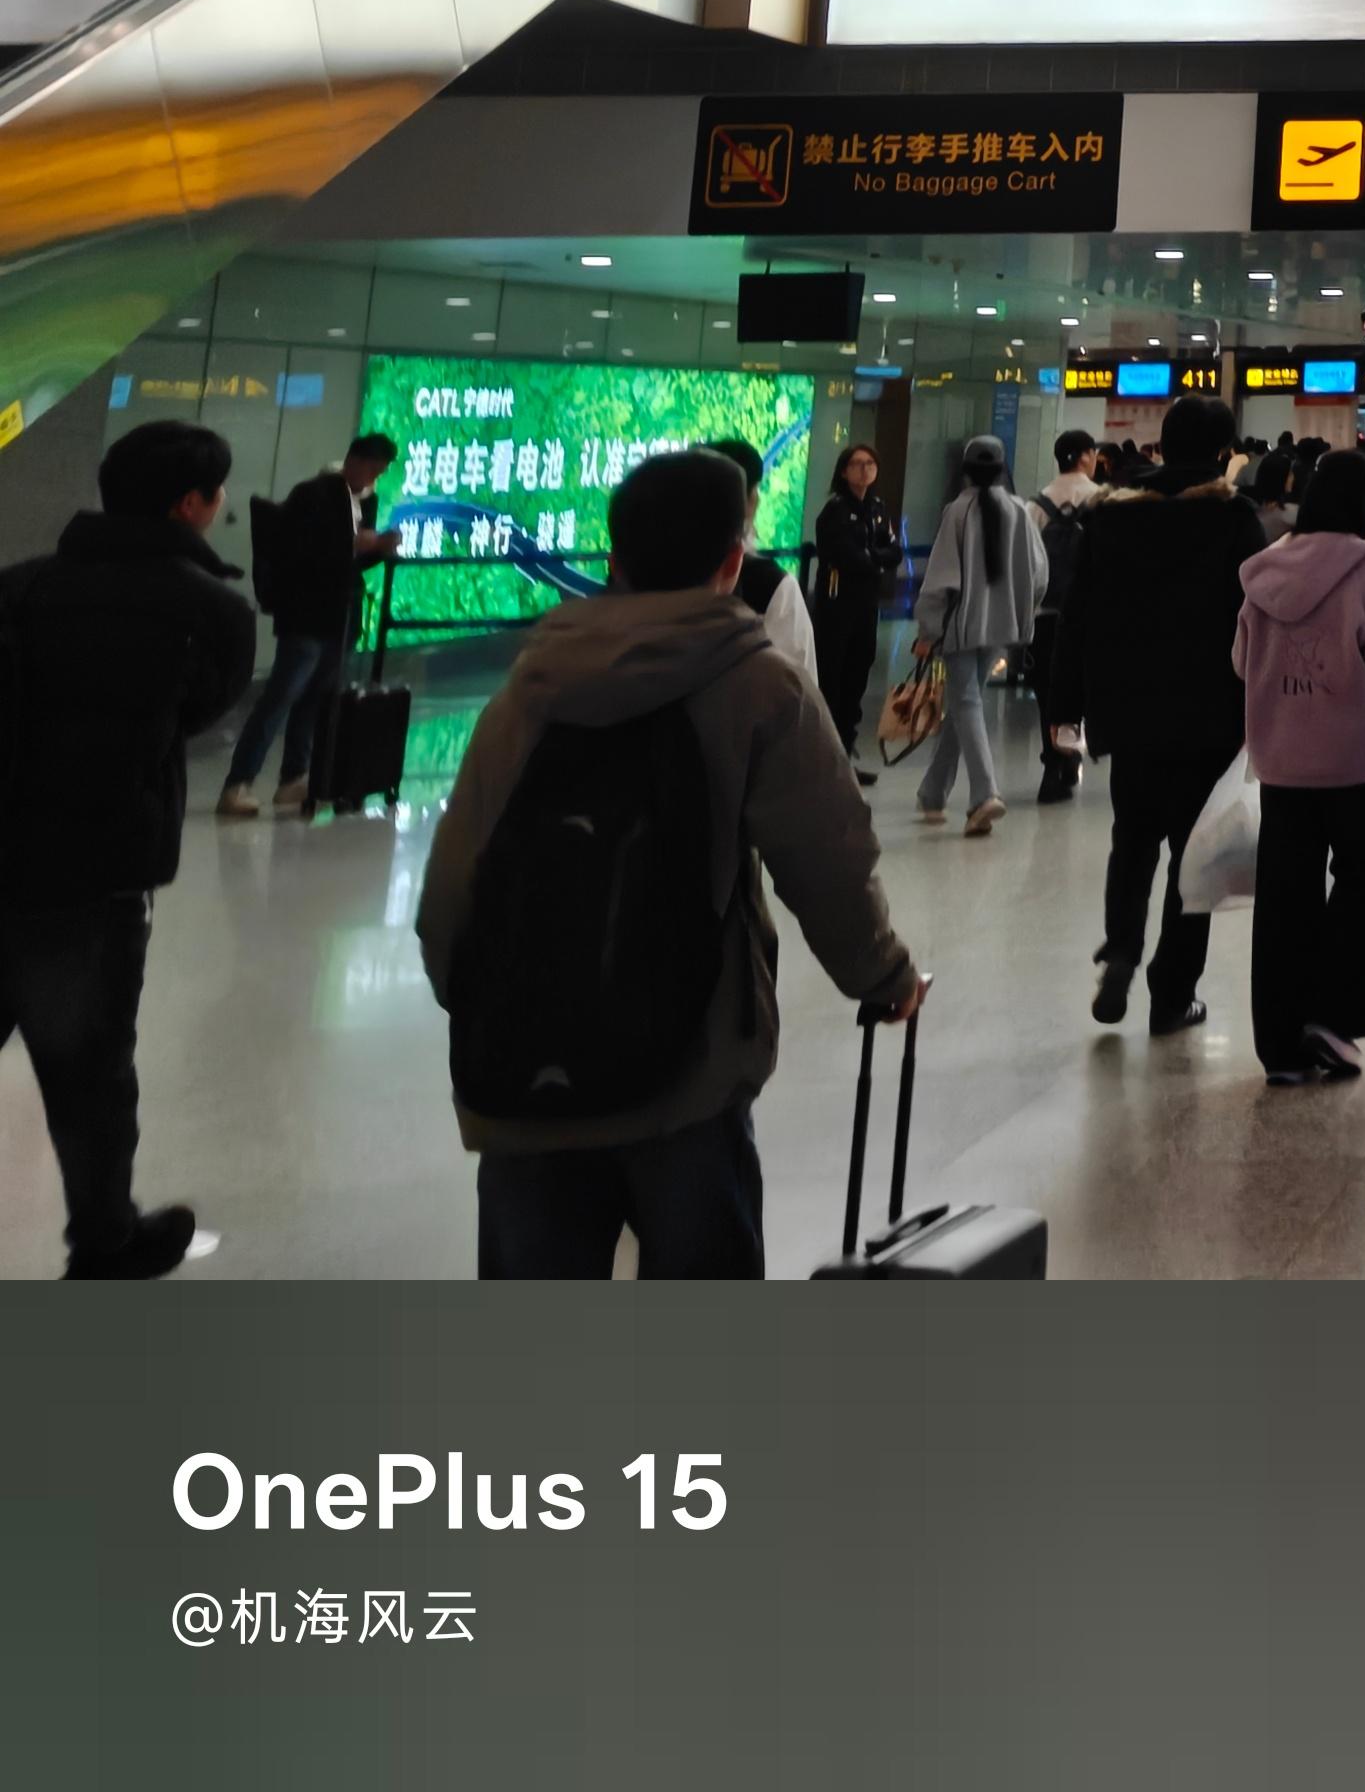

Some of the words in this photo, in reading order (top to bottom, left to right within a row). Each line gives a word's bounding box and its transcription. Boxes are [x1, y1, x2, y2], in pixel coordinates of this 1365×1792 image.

[802, 131, 1104, 166] 禁止行李手推车入内
[855, 172, 886, 193] No
[895, 172, 999, 197] Baggage
[1008, 171, 1057, 191] Cart
[1181, 368, 1216, 388] 411
[415, 387, 461, 418] CATL
[402, 437, 566, 496] 选电车看电池
